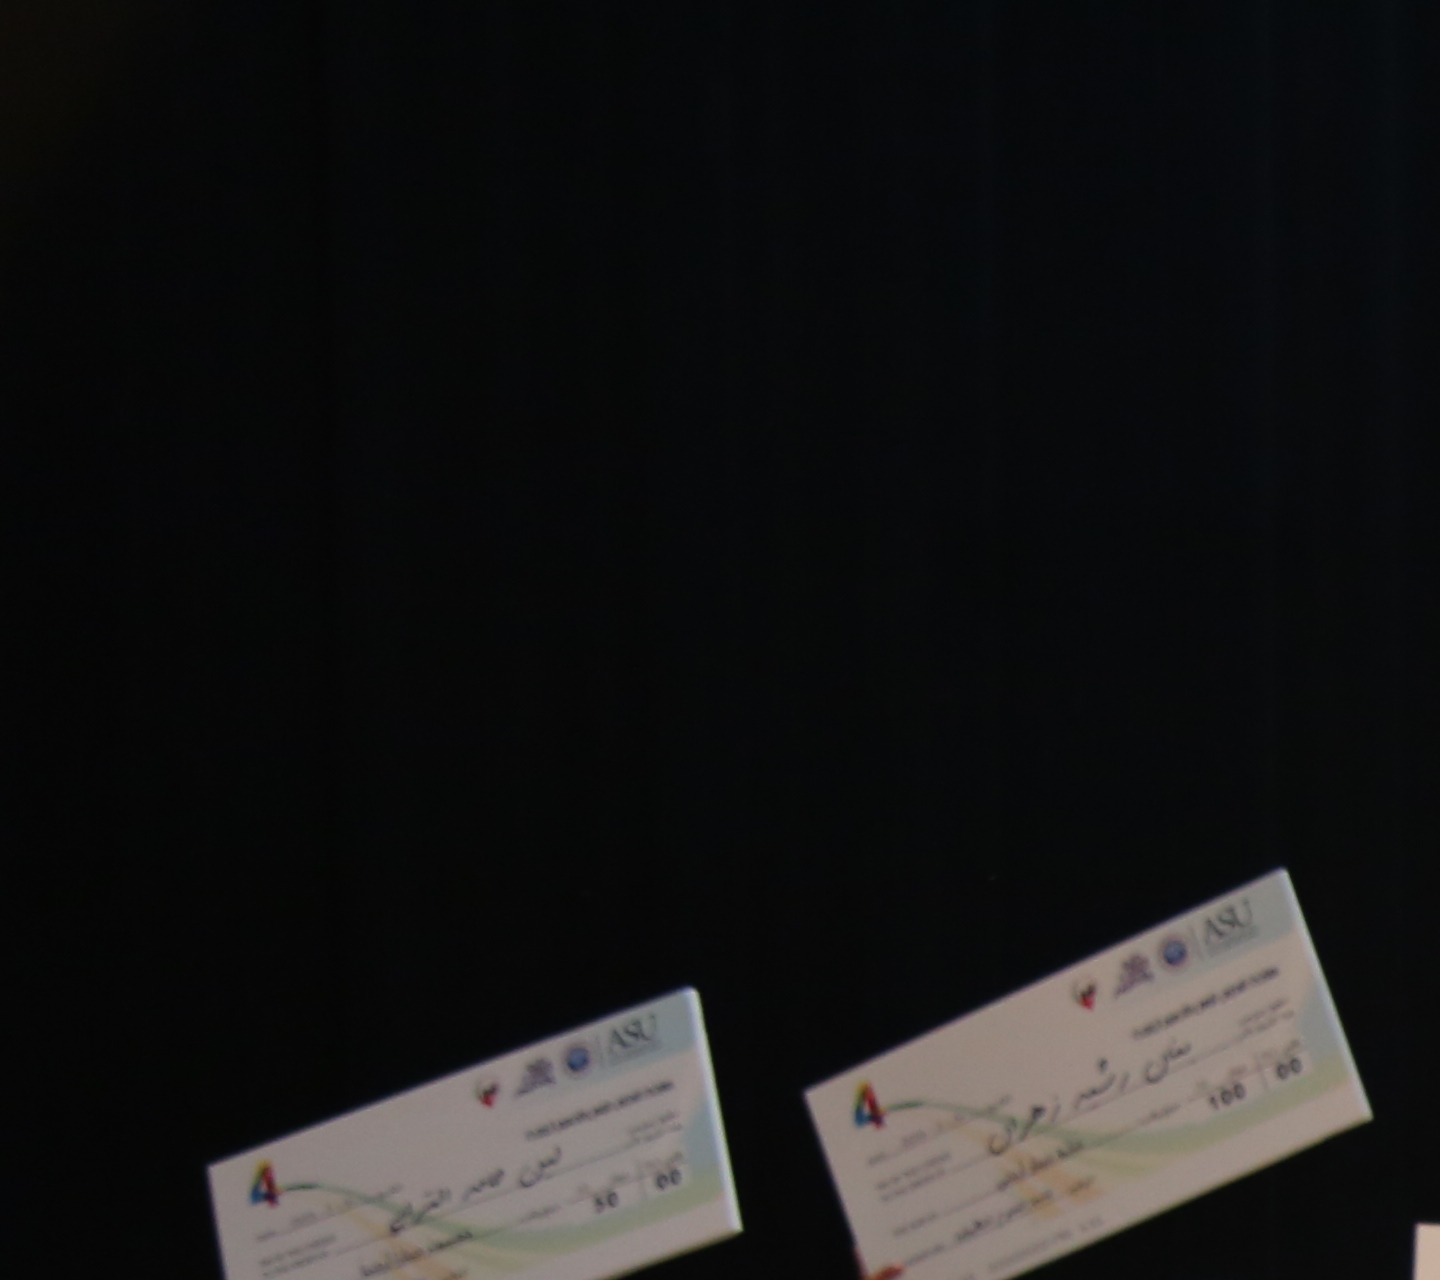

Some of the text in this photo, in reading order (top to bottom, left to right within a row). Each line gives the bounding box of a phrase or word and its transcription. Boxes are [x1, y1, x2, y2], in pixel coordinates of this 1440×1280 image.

[1201, 899, 1255, 945] ASU
[608, 1014, 659, 1054] ASU
[854, 1079, 887, 1130] 4
[1206, 1054, 1304, 1112] 100 00
[249, 1159, 280, 1208] 4
[592, 1166, 683, 1213] 50 00
